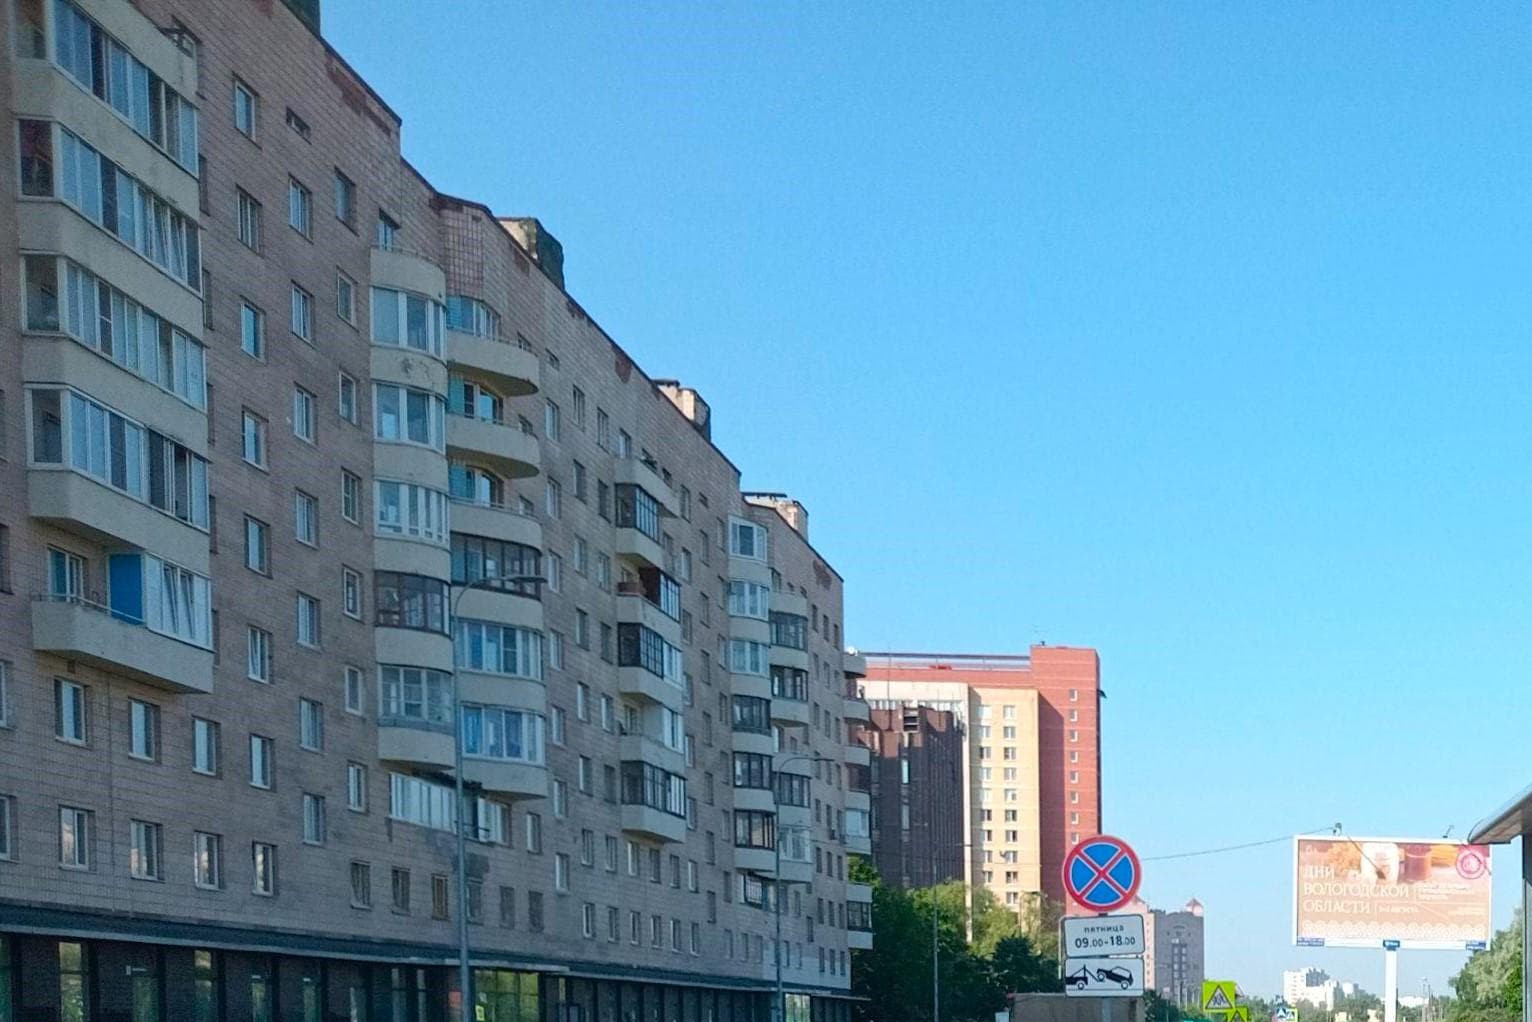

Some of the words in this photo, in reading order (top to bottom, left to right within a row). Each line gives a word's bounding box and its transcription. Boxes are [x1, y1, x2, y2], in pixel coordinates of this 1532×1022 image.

[1303, 865, 1335, 880] ДНИ
[1303, 882, 1409, 898] ВОЛОГОДСКОЙ
[1303, 900, 1371, 914] ОБЛАСТИ
